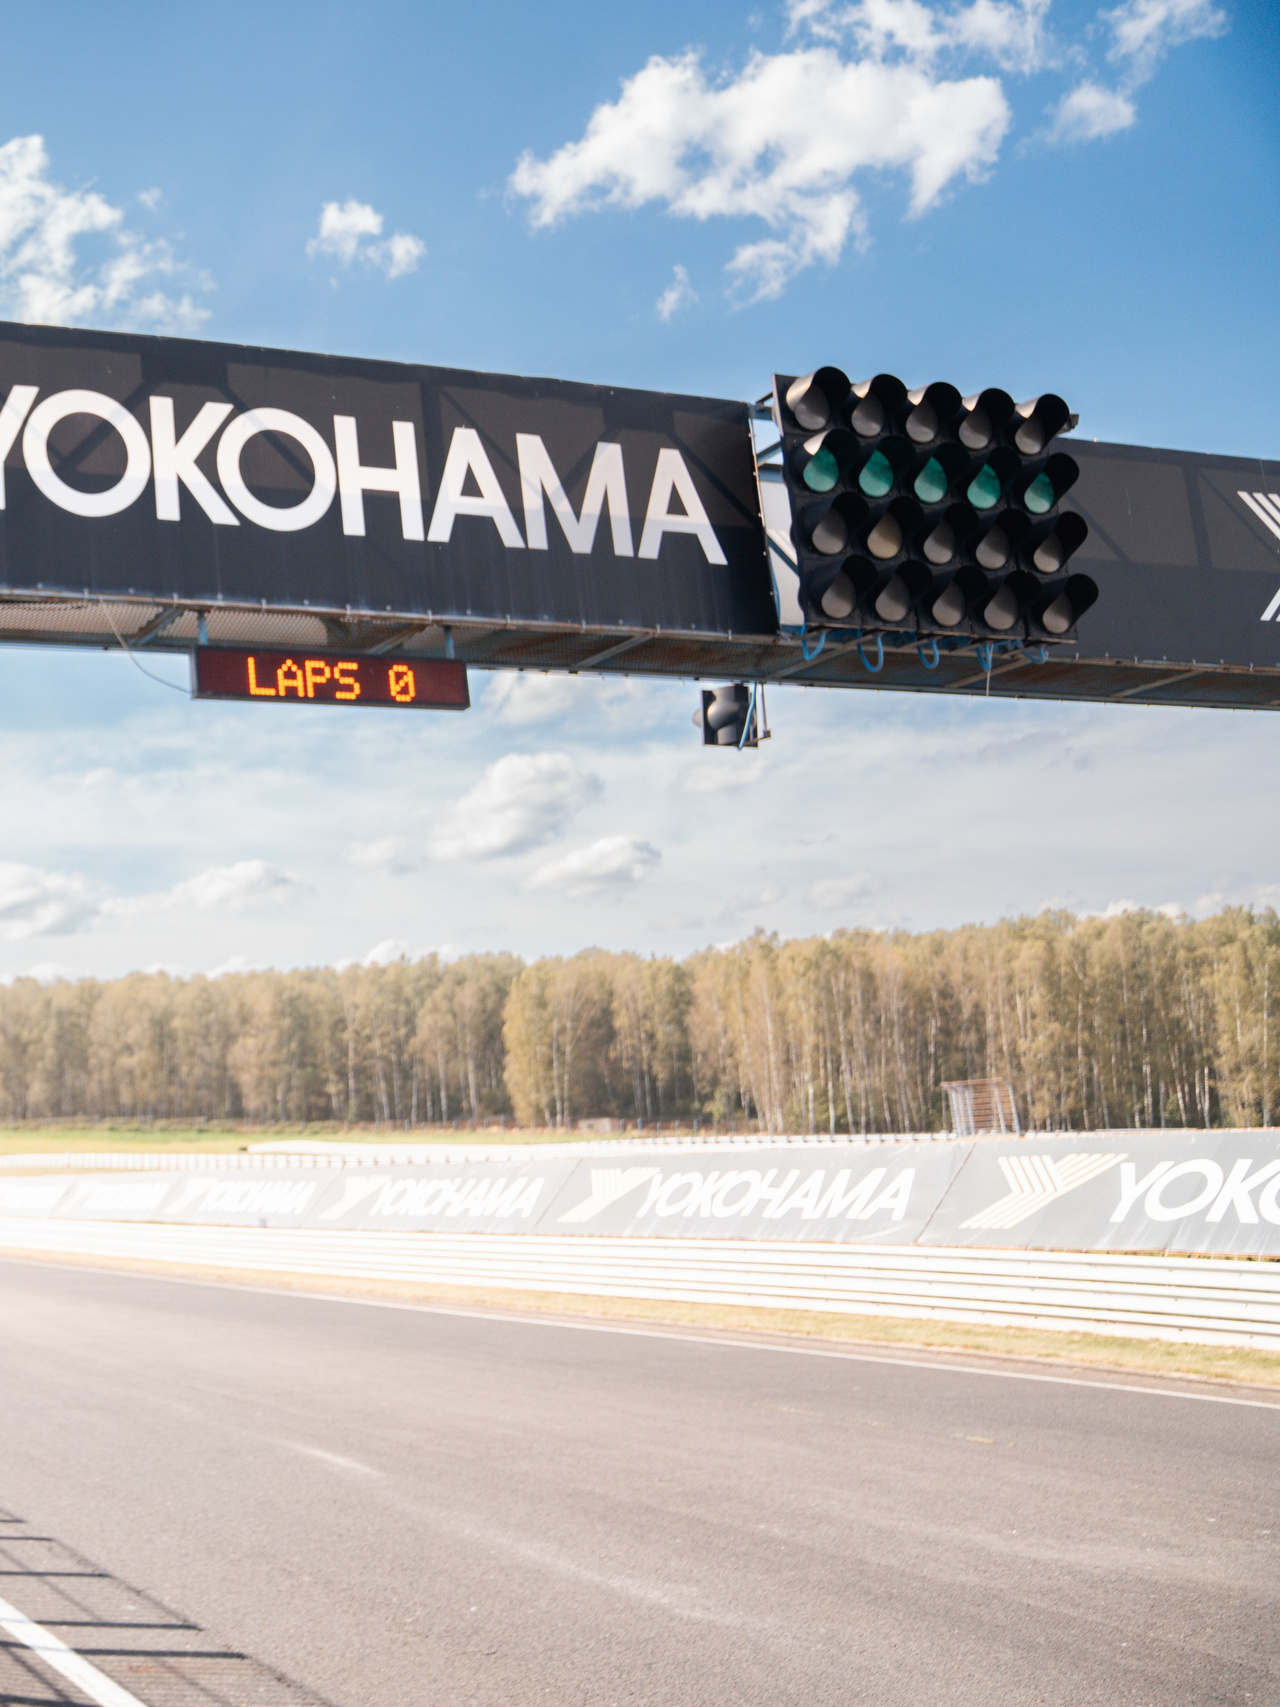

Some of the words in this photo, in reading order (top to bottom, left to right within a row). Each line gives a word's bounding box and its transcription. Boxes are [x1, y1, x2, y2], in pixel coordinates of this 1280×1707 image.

[247, 656, 360, 700] LAPS
[388, 664, 416, 702] 0
[369, 1175, 545, 1218] YOKOHAMA
[636, 1167, 916, 1221] YOKOHAMA
[1109, 1158, 1280, 1226] YOK
